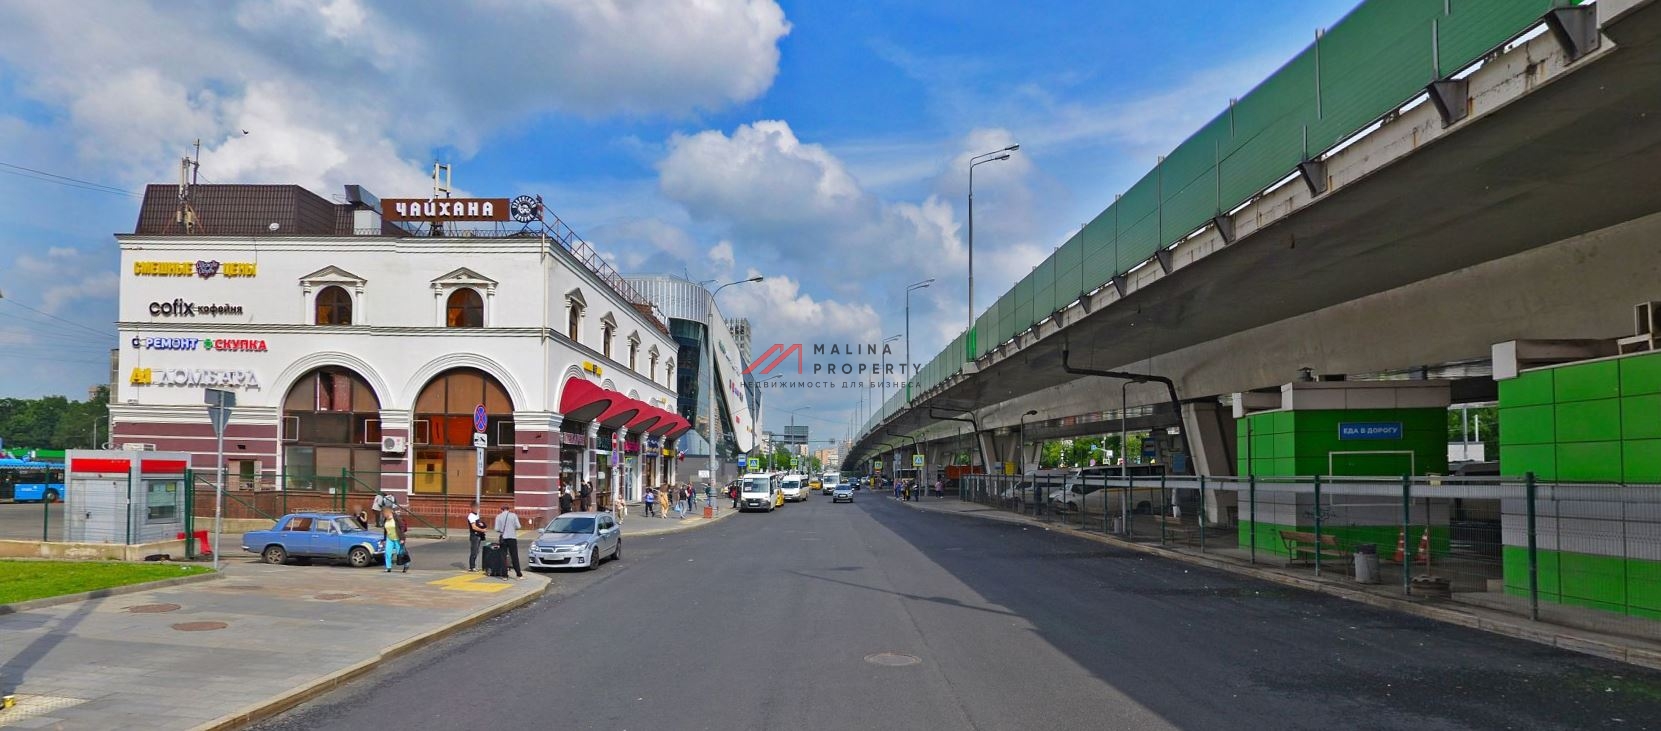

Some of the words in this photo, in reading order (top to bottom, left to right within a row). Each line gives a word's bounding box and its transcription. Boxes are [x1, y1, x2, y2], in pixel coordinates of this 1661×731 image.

[396, 199, 493, 217] ЧАЙХАНА
[134, 261, 193, 276] СМЕШНЫЕ
[223, 262, 257, 278] ЦЕНЫ
[149, 298, 195, 317] cofix
[197, 303, 243, 317] кофейня
[146, 338, 199, 350] РЕМОНТ
[214, 339, 268, 352] СКУПКА
[154, 369, 260, 392] ЛОМБАРД
